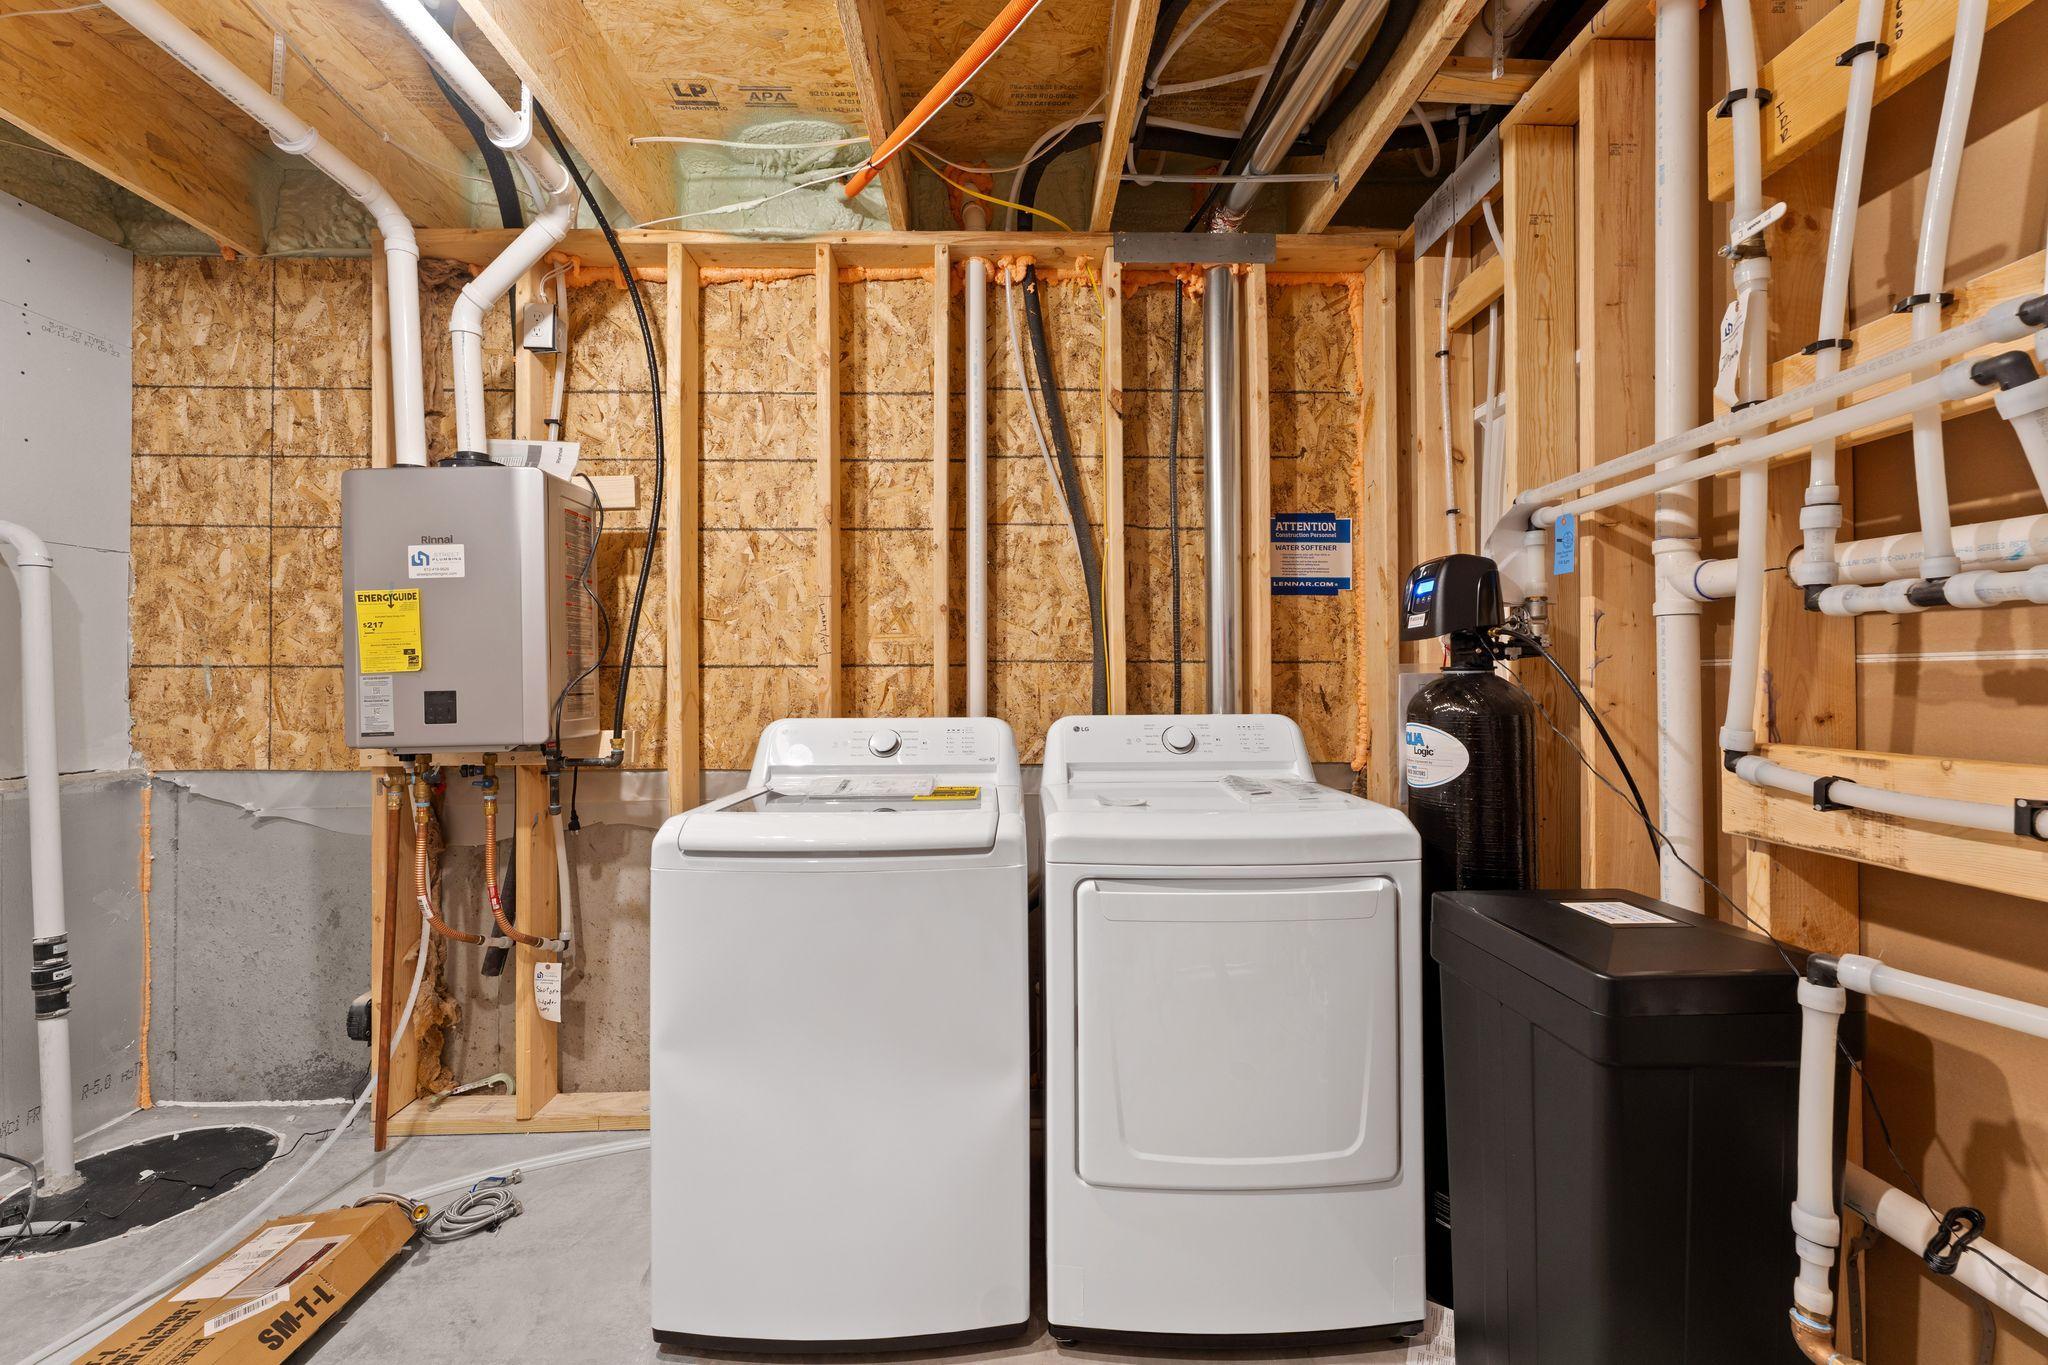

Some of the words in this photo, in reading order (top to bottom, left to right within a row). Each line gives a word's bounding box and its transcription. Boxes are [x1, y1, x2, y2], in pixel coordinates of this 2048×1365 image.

[671, 82, 707, 97] LP
[749, 91, 787, 101] APA
[1275, 522, 1337, 532] ATTENTION
[362, 621, 384, 629] $217
[1414, 744, 1434, 758] Logic
[137, 1308, 189, 1341] Large
[258, 1285, 336, 1351] SM-T-L
